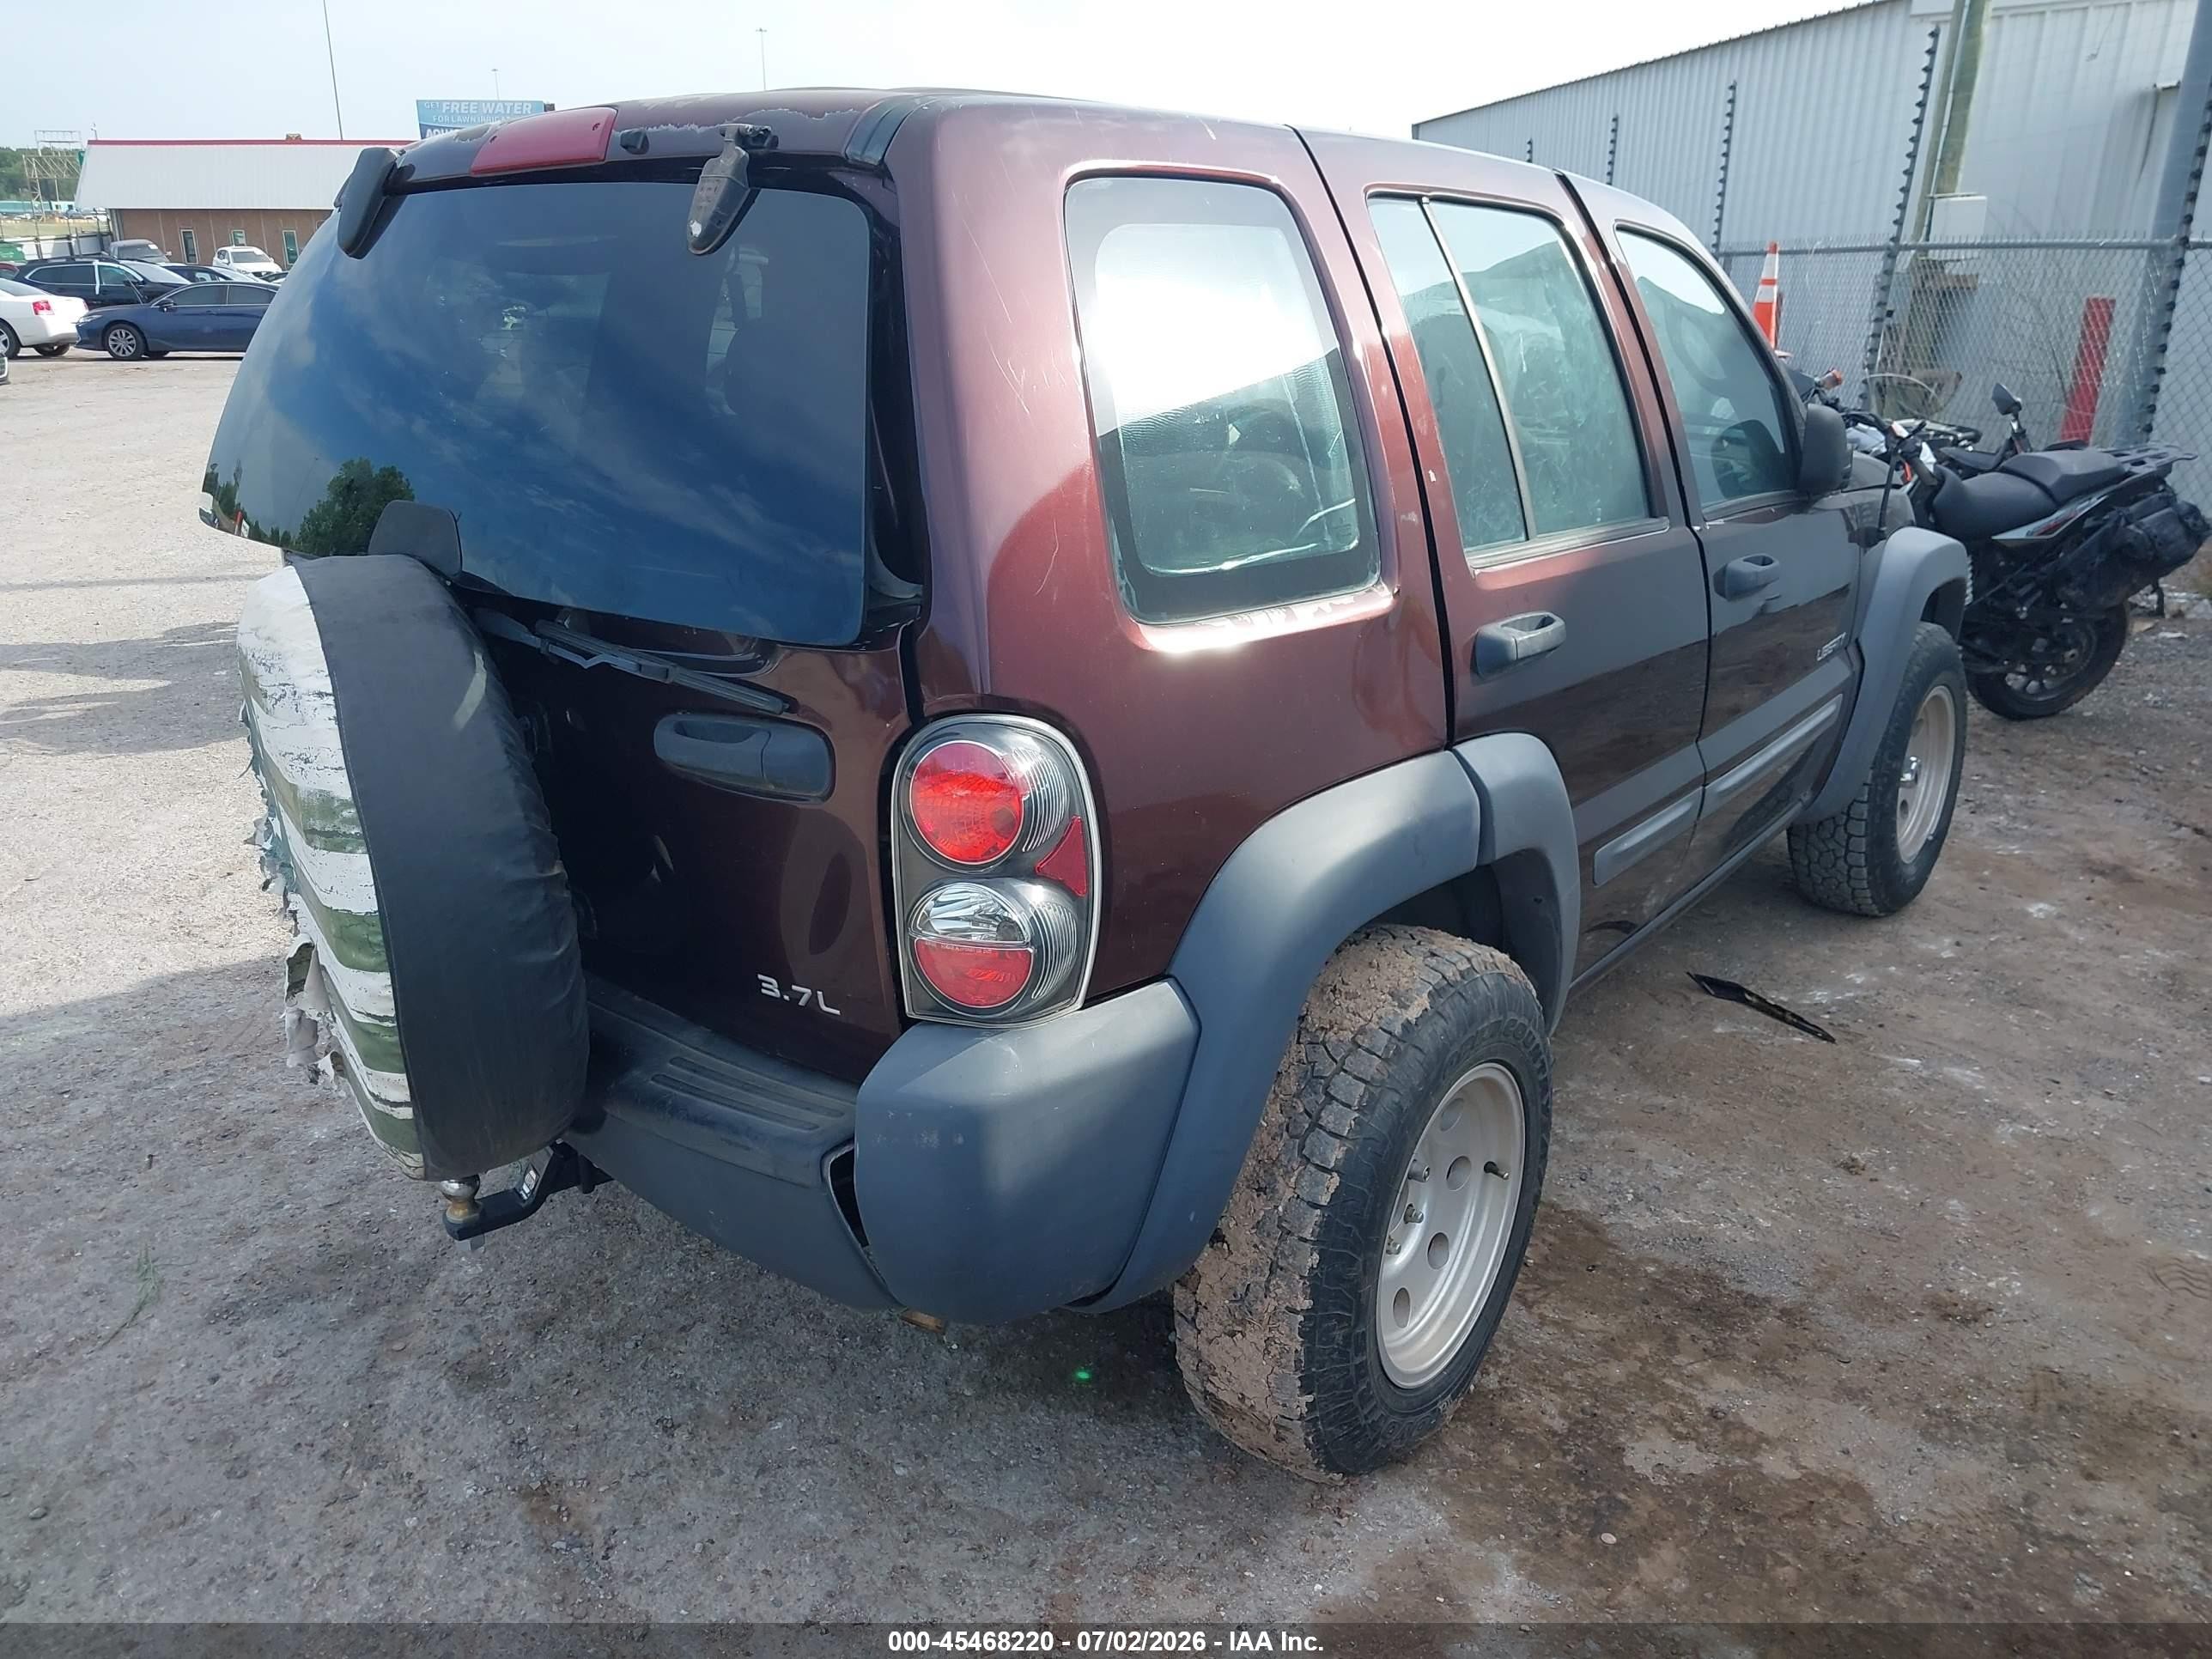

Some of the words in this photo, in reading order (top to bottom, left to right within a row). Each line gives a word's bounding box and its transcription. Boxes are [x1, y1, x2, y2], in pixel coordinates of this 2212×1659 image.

[424, 101, 440, 110] GET
[442, 102, 478, 114] FREE
[483, 102, 532, 114] WATER
[433, 116, 450, 125] FOR
[452, 116, 477, 125] LAWN
[757, 973, 842, 1017] 3.7L
